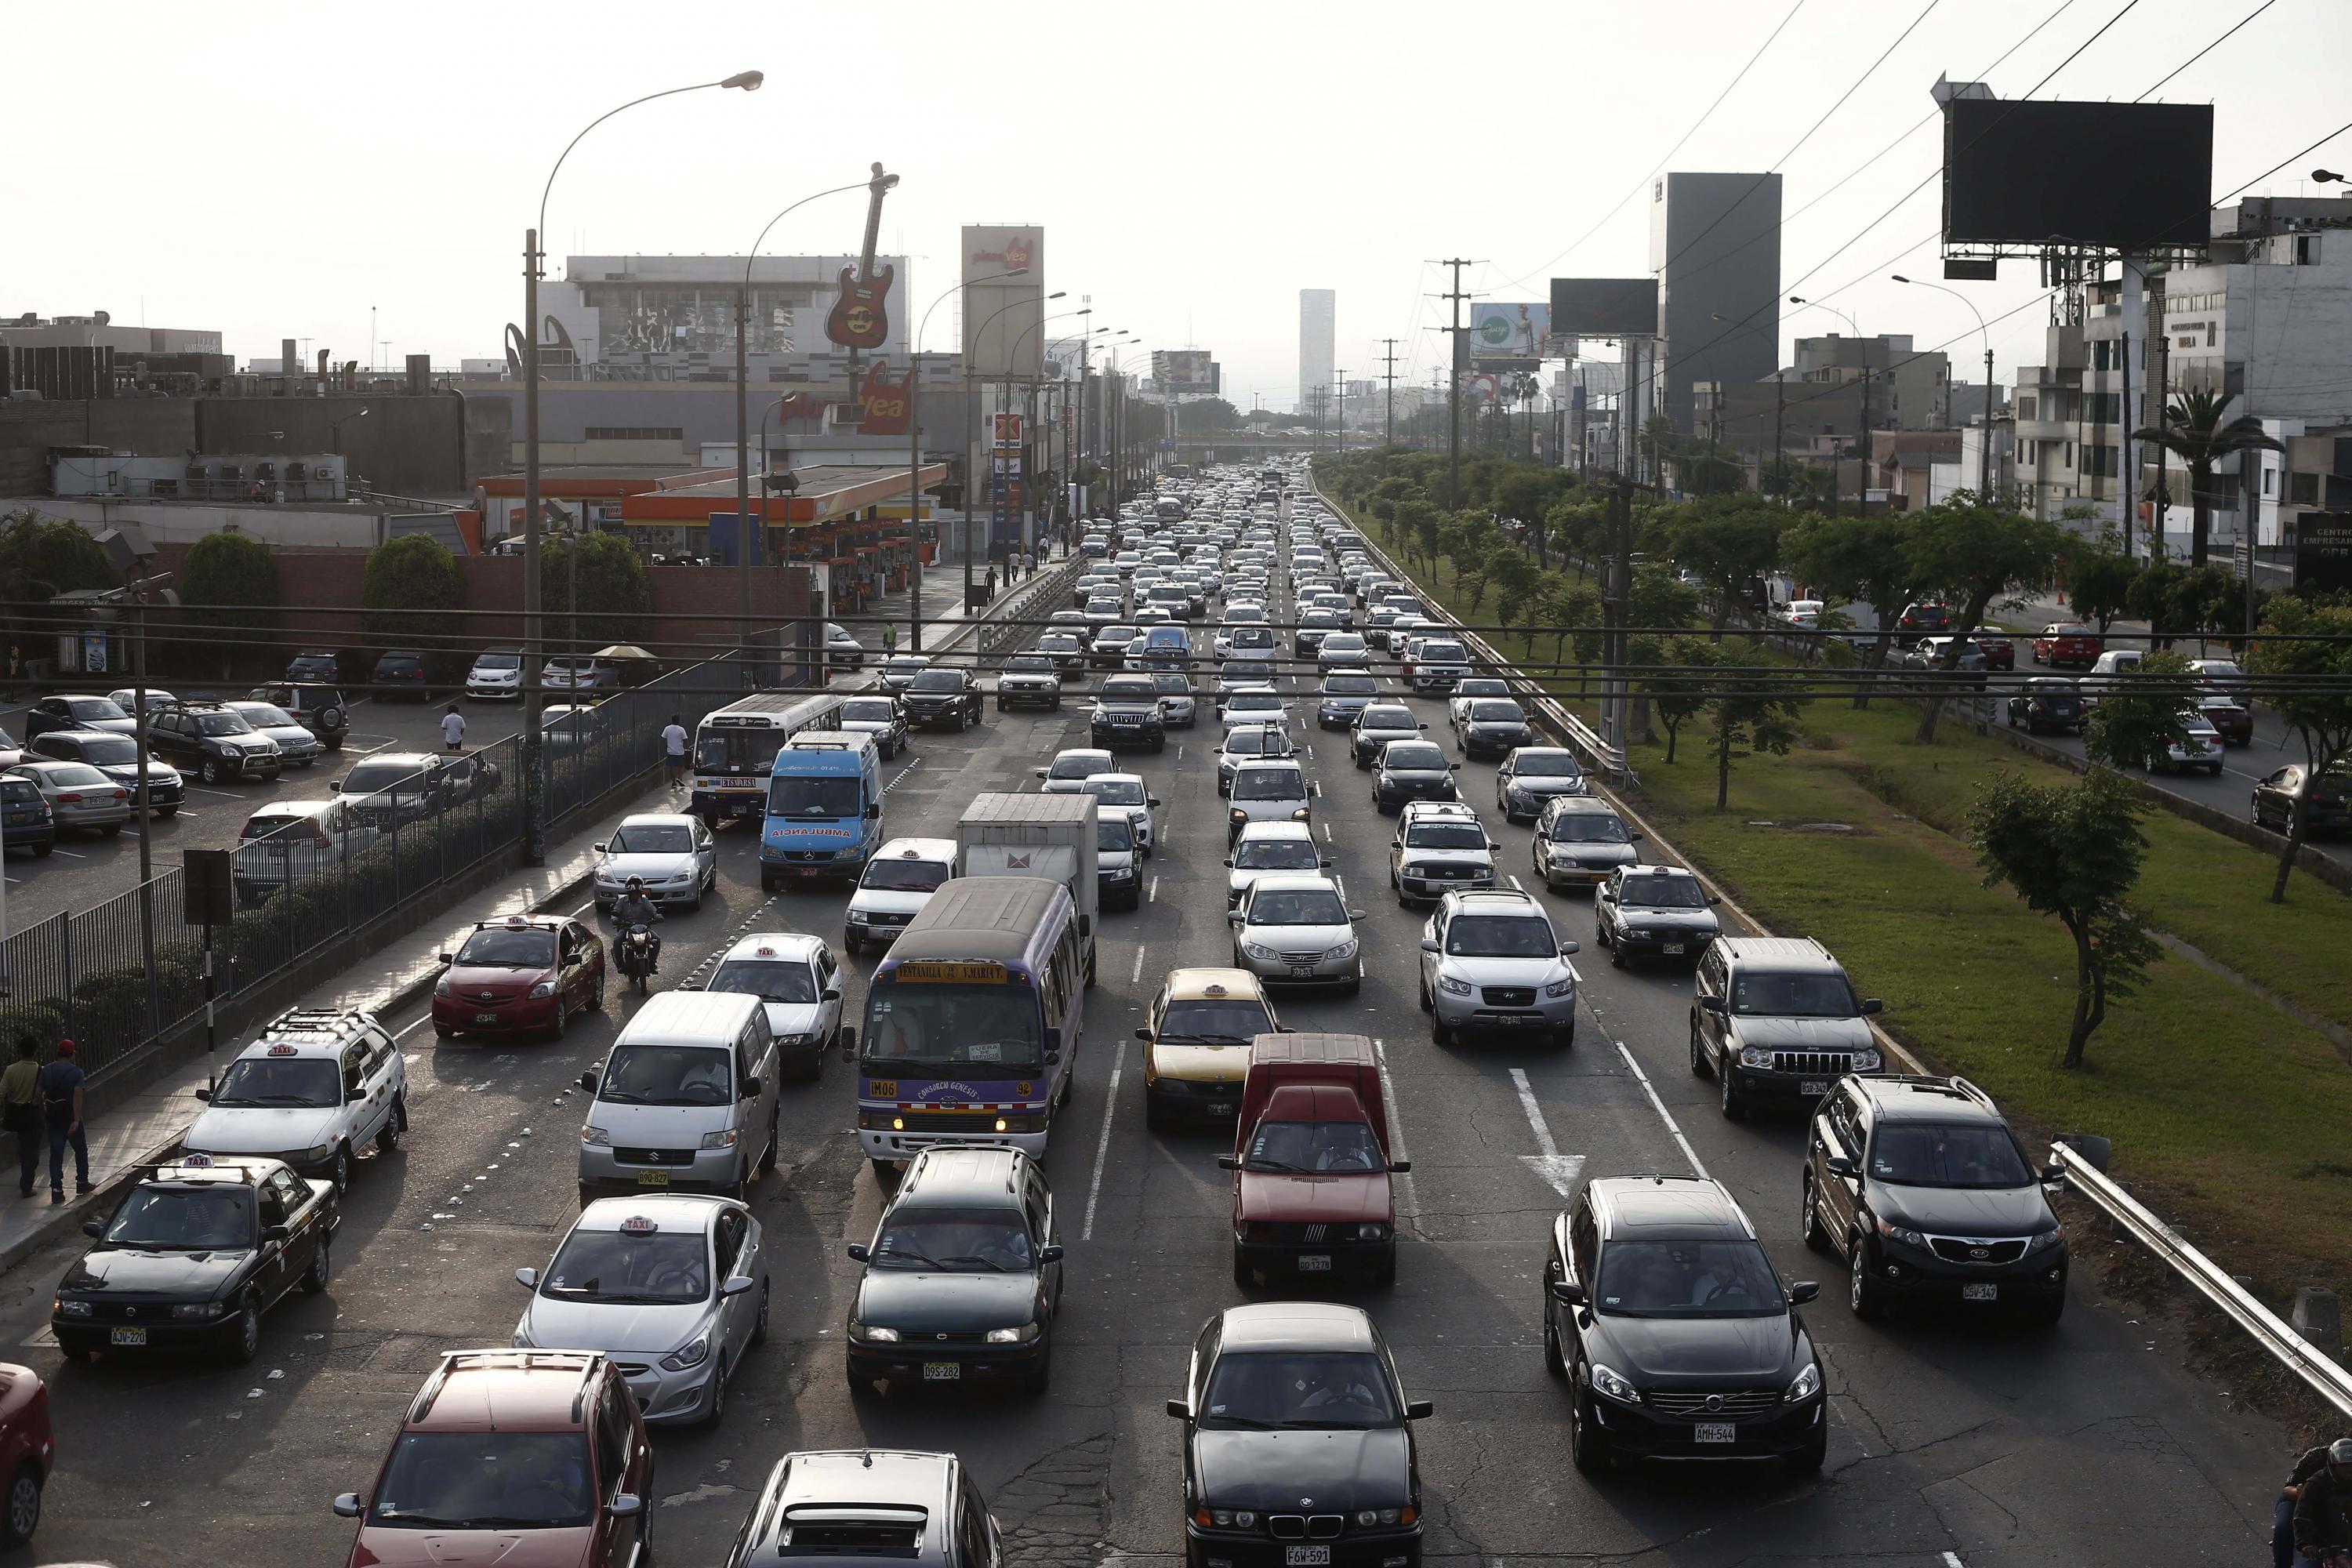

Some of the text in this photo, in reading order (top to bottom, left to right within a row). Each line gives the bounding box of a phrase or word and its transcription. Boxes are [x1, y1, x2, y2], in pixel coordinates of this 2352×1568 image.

[1006, 252, 1027, 262] Vea
[722, 778, 756, 787] ETSMARSA
[899, 965, 941, 978] VENTANILLA
[917, 1081, 978, 1099] CONSORCIO GENESIS
[1018, 1083, 1029, 1094] 92
[188, 1157, 208, 1166] TAXI
[639, 1174, 667, 1183] B9Q-827
[627, 1220, 648, 1229] TAXI
[113, 1332, 145, 1342] AJV-270
[924, 1367, 959, 1377] D9S-282
[1697, 1428, 1733, 1440] AMH-544
[1287, 1551, 1329, 1563] F6W-591
